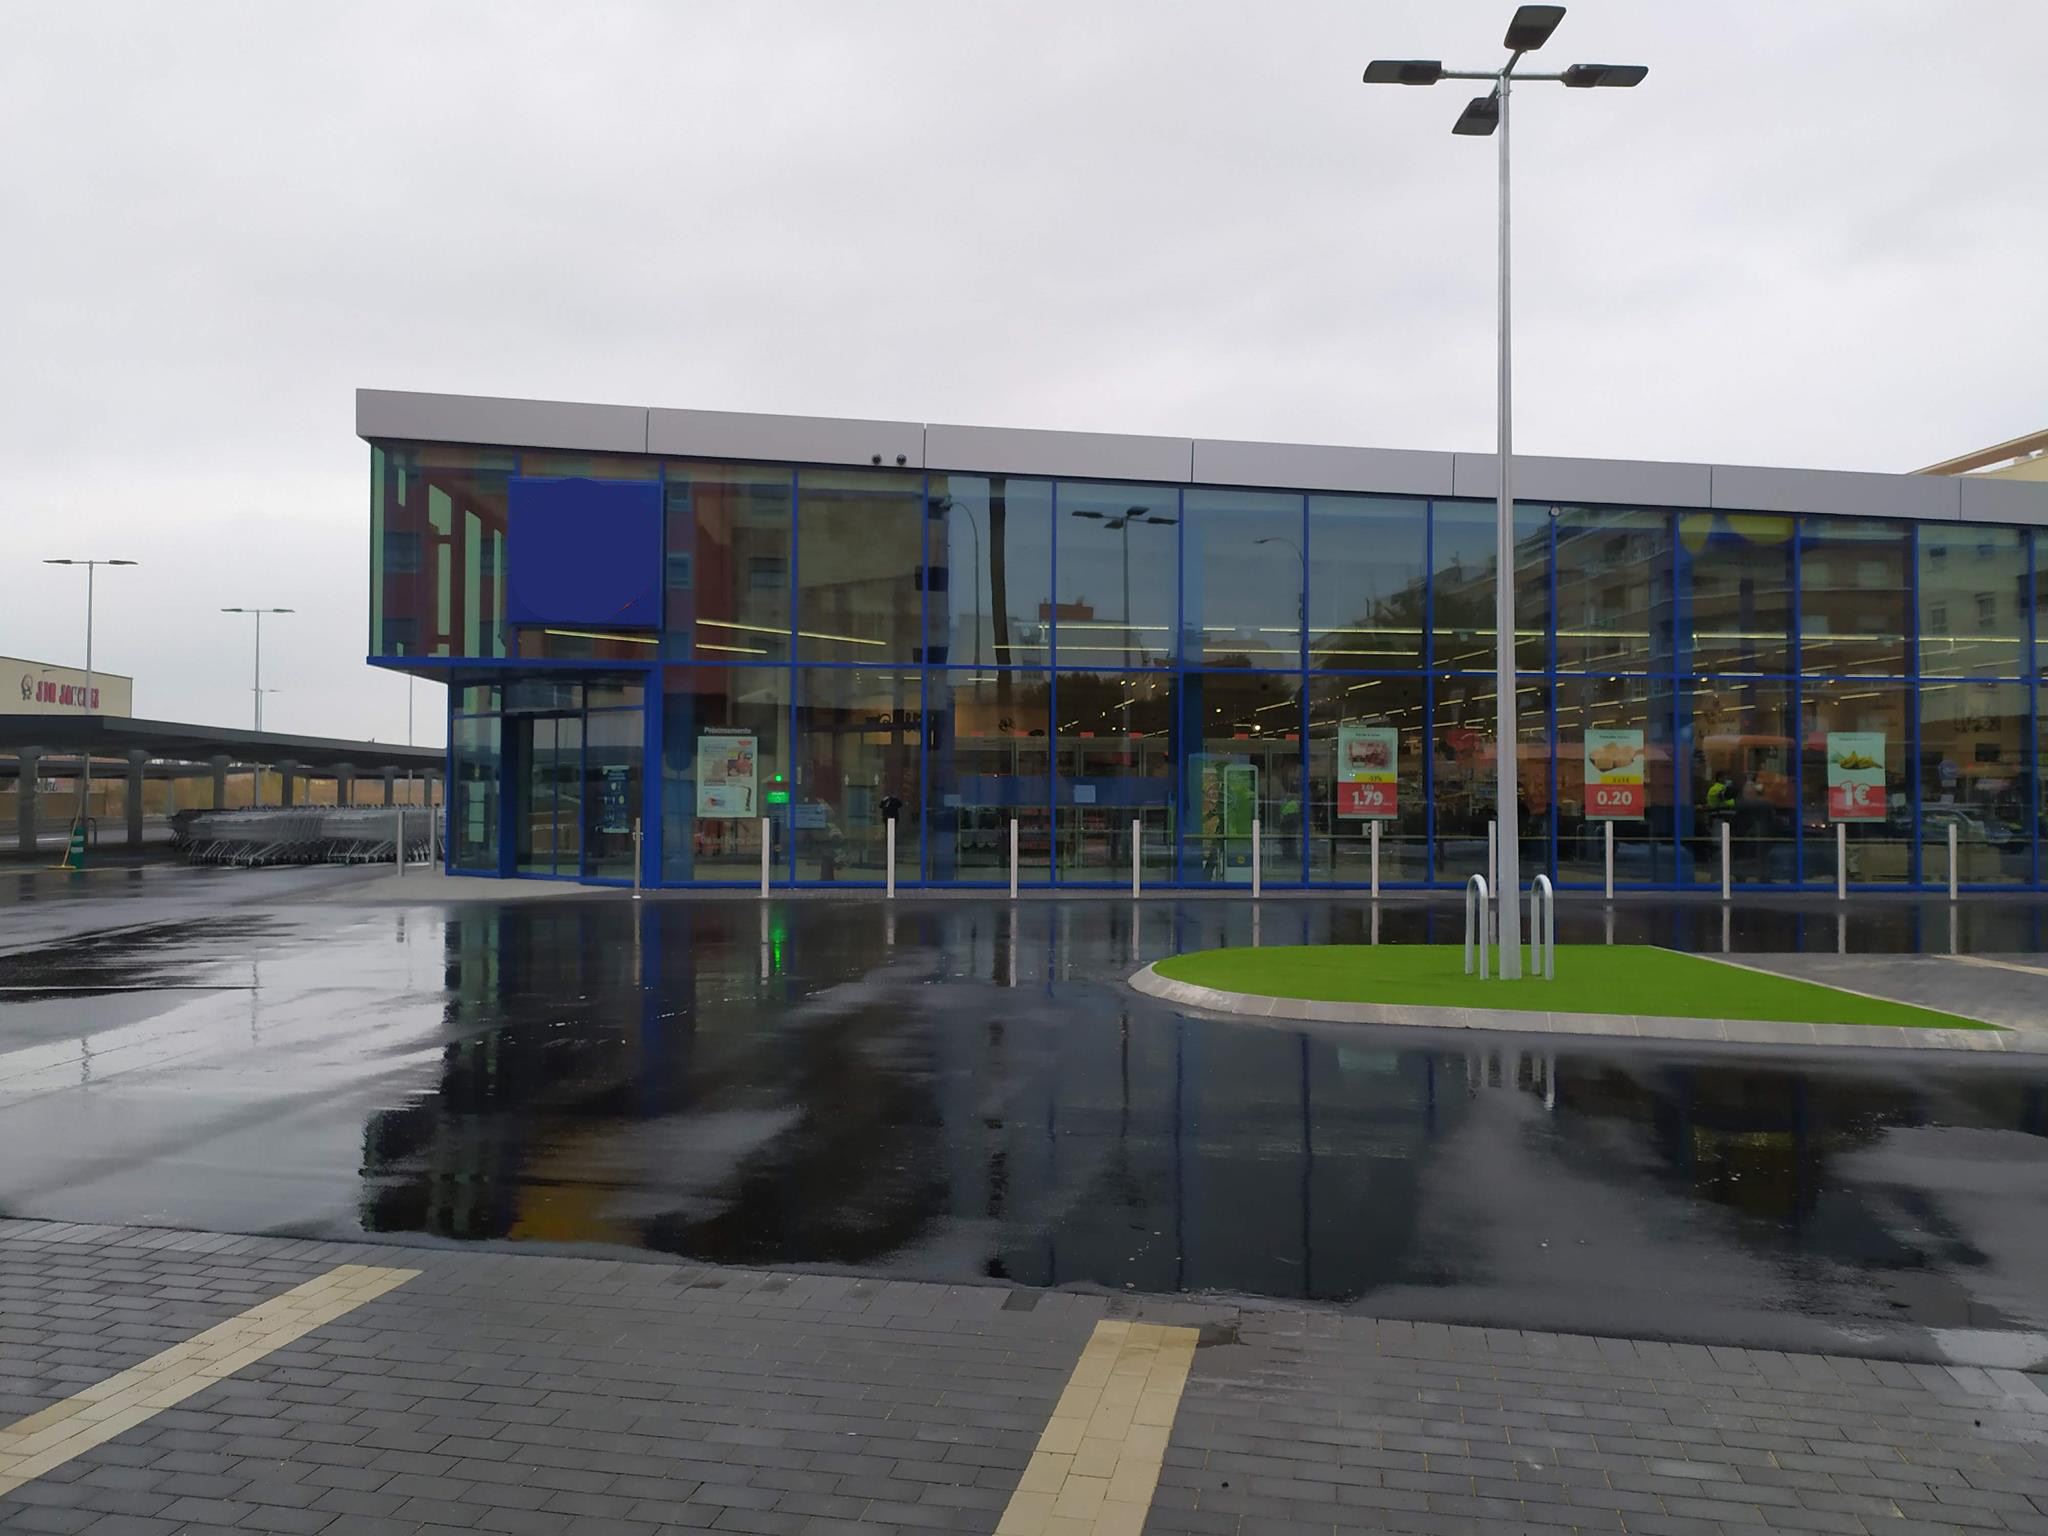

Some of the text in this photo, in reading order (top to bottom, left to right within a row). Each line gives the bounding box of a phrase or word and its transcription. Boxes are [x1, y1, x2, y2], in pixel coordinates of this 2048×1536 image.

[1352, 790, 1384, 806] 1.79
[1597, 791, 1633, 805] 0.20
[1841, 782, 1872, 806] 1€
